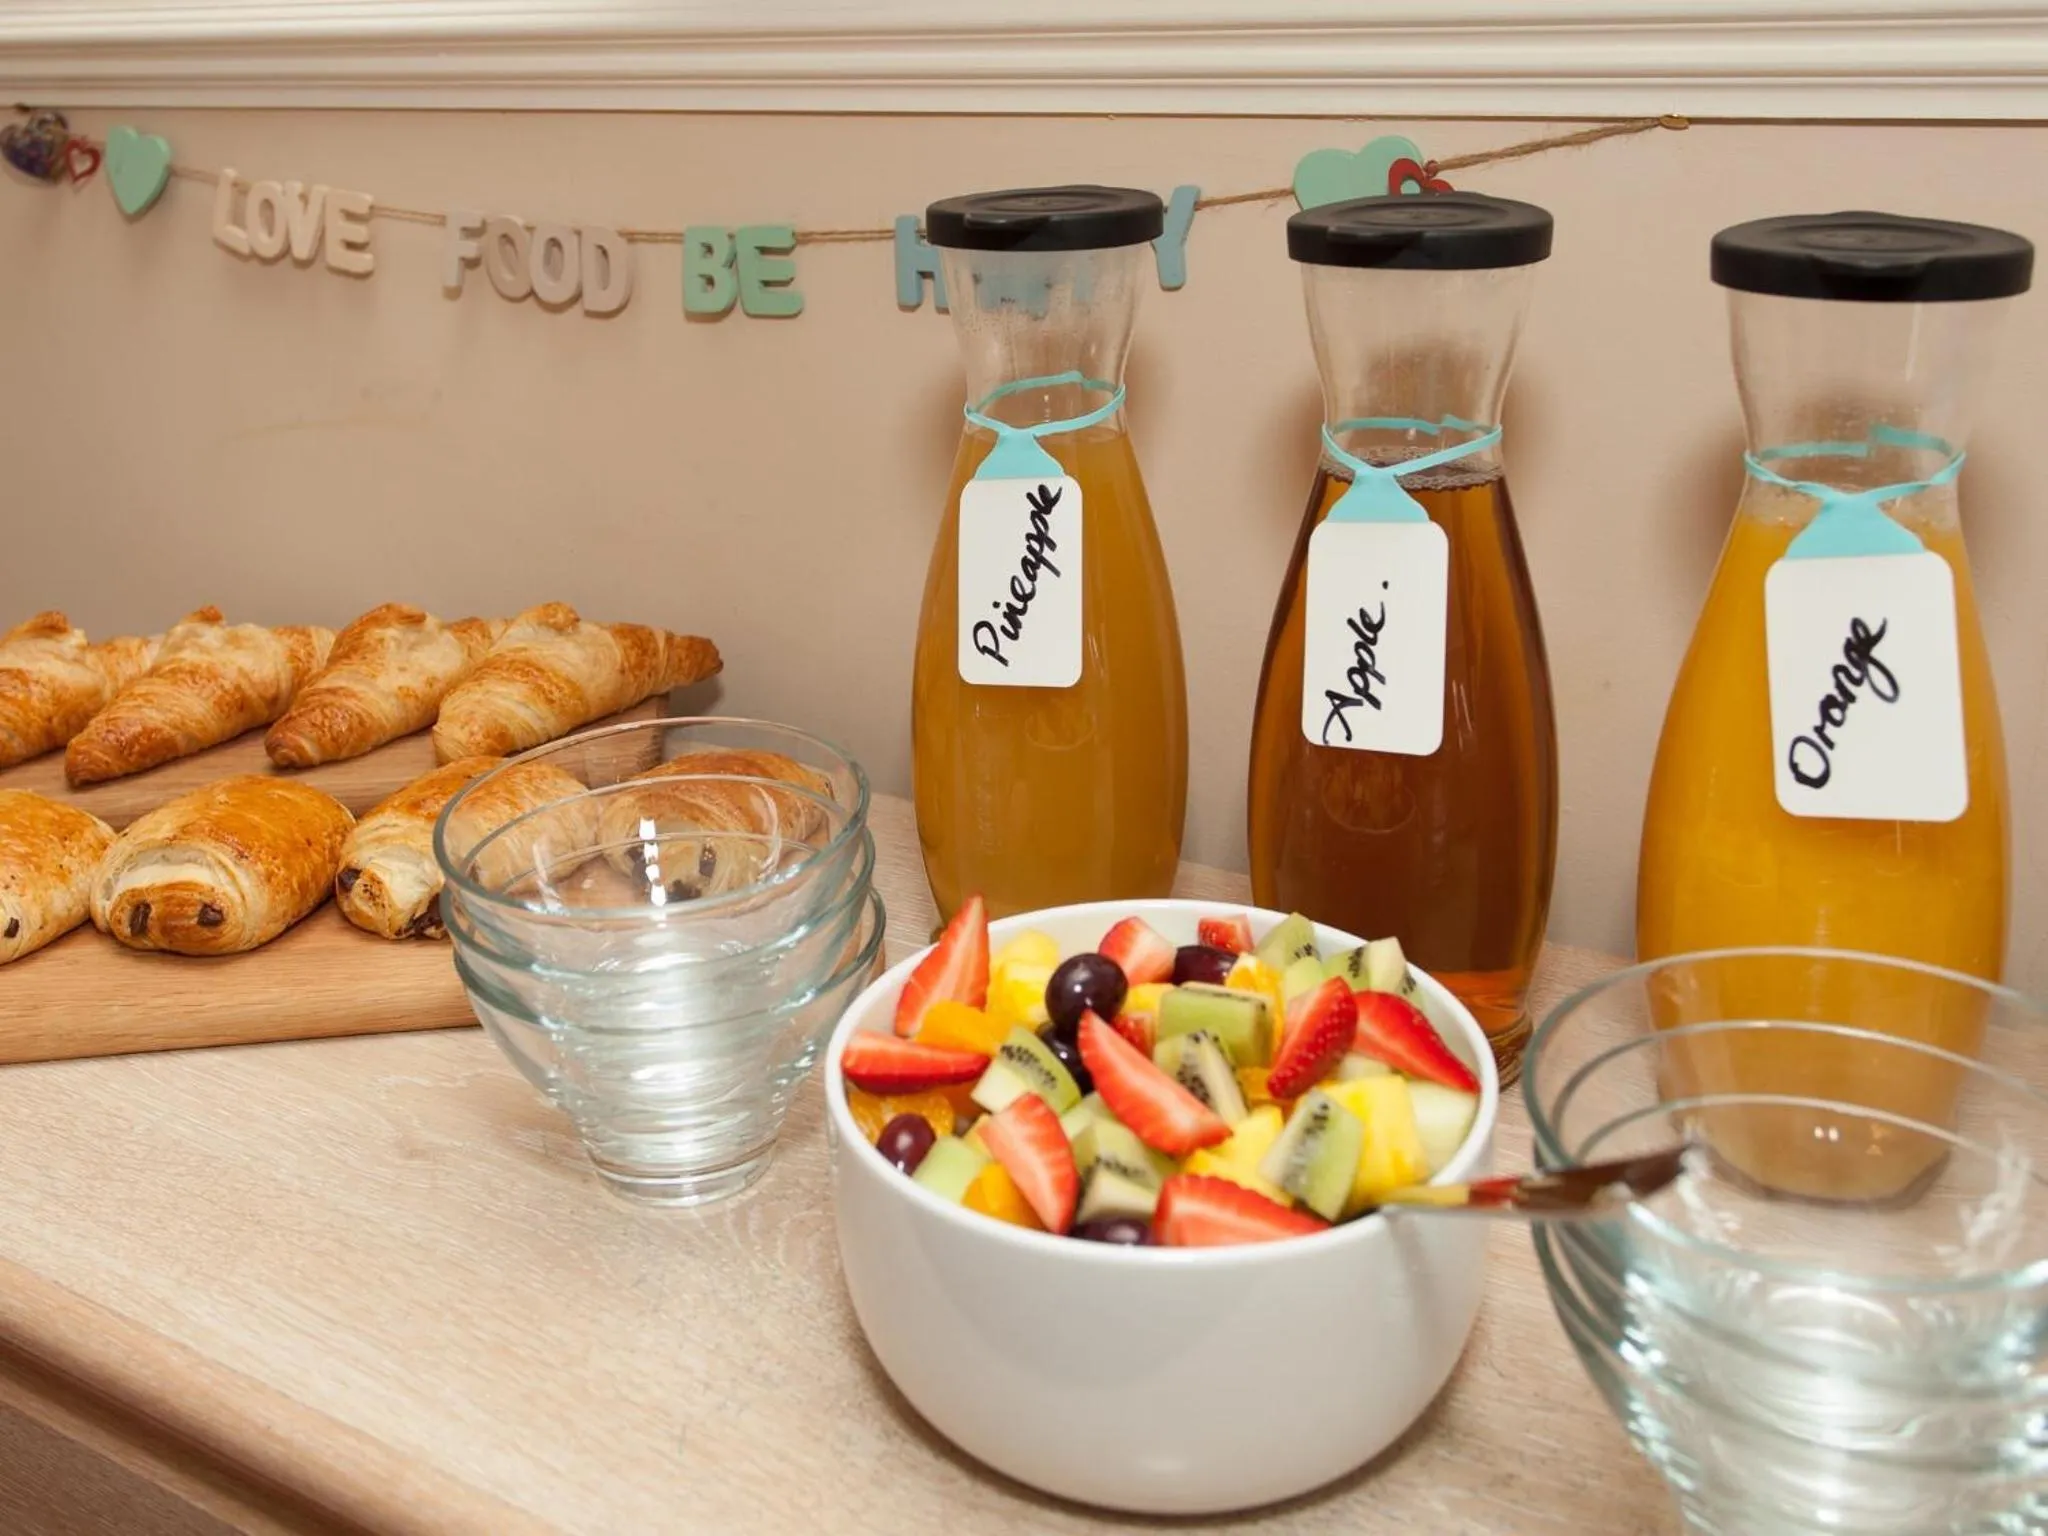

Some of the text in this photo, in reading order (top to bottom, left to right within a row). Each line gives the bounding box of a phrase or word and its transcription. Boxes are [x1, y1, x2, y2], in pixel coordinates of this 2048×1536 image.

[211, 168, 376, 277] LOVE
[441, 209, 635, 317] FOOD
[681, 224, 804, 320] BE
[973, 484, 1063, 667] Pineapple
[1789, 617, 1899, 789] Orange
